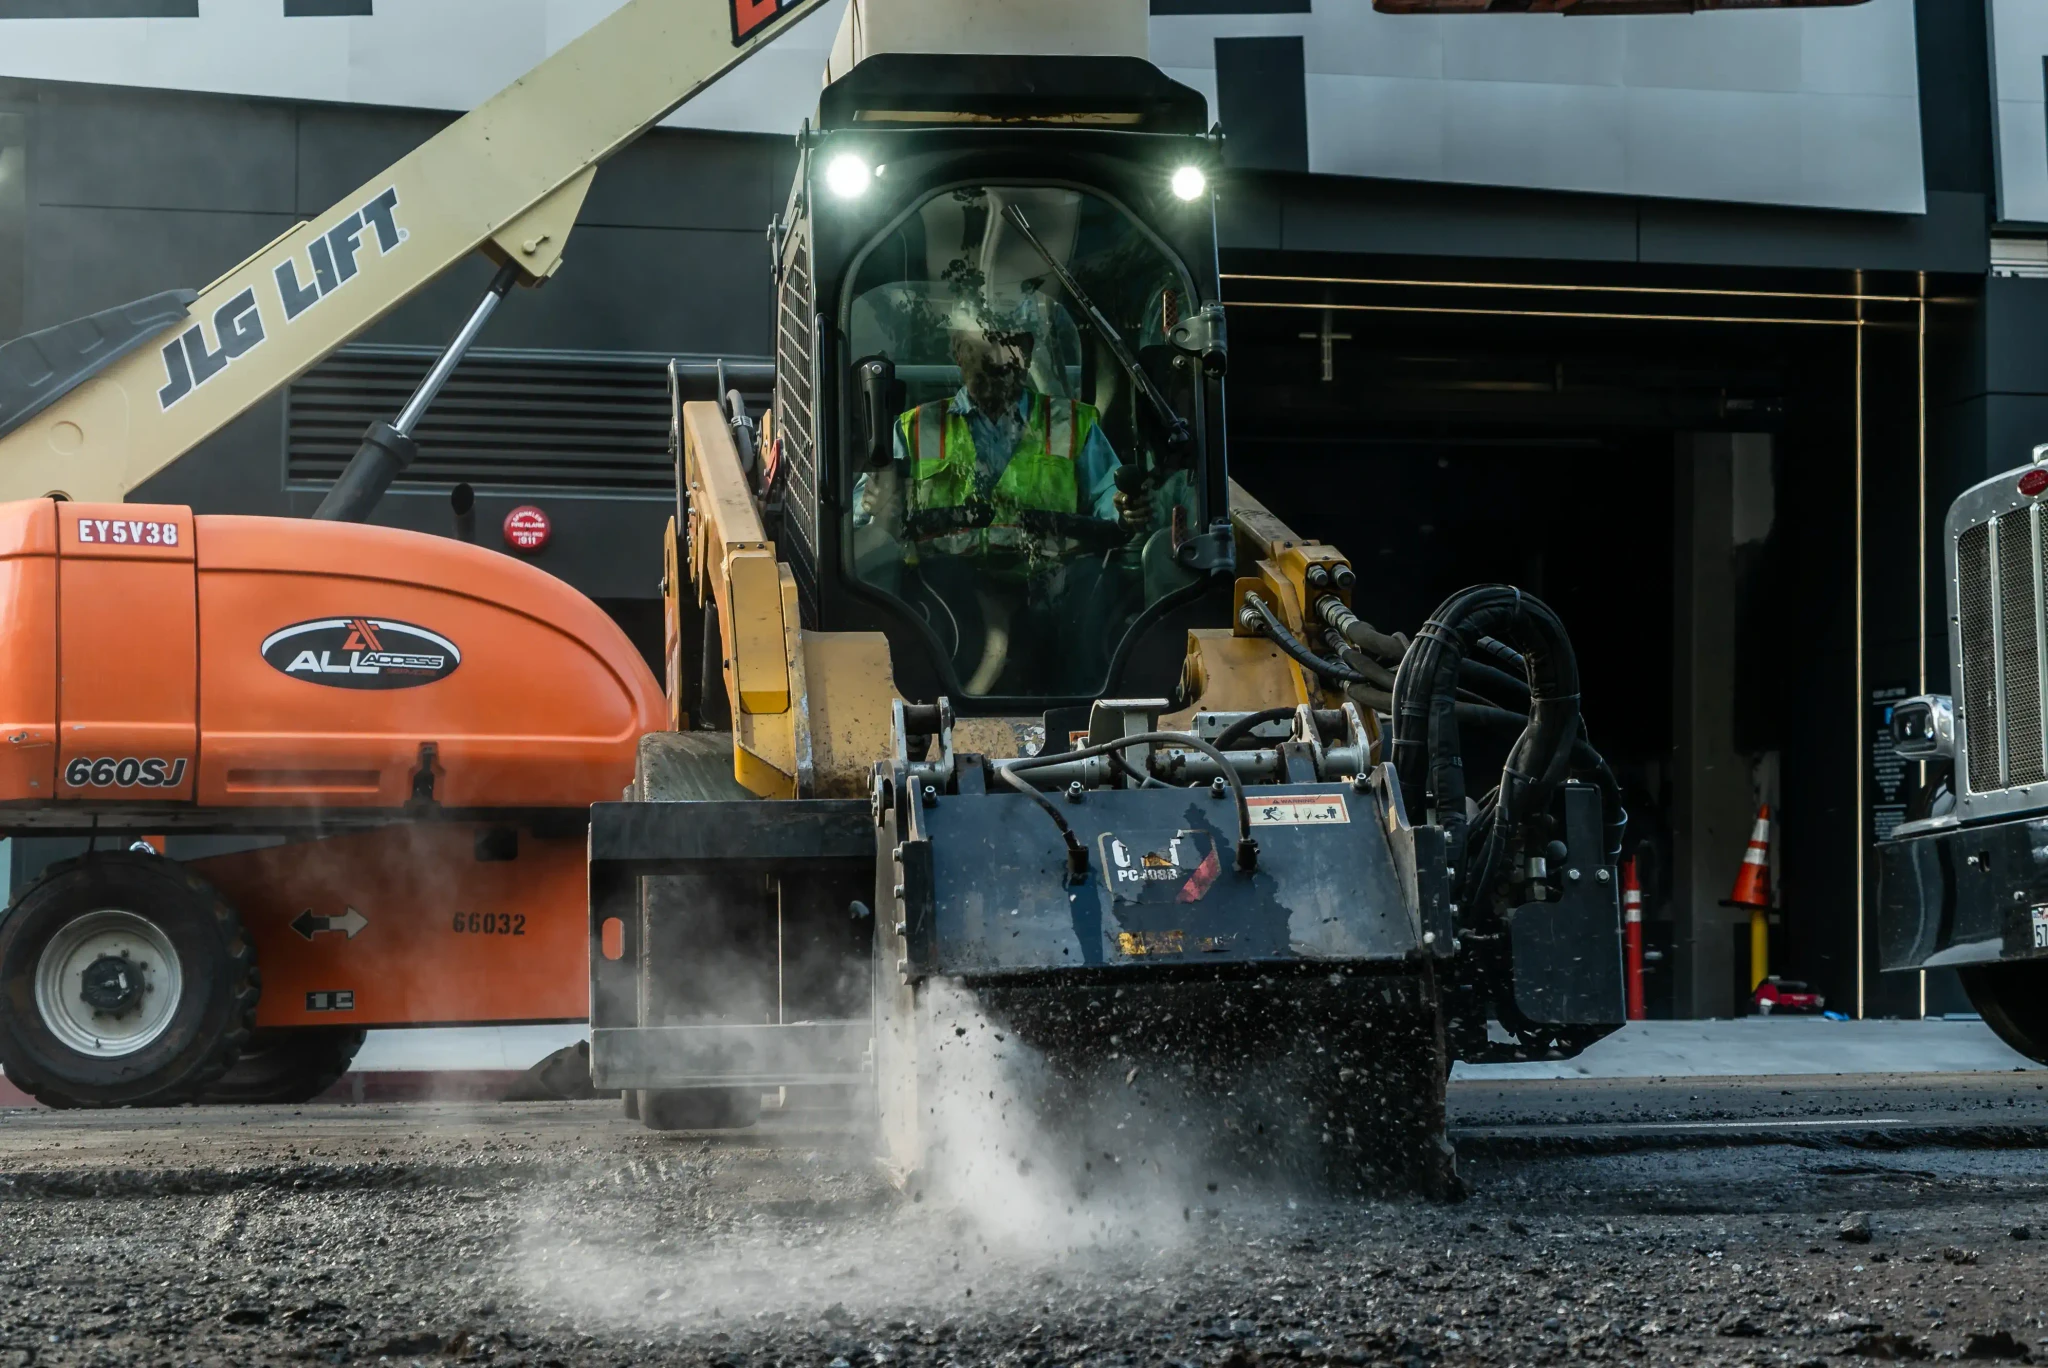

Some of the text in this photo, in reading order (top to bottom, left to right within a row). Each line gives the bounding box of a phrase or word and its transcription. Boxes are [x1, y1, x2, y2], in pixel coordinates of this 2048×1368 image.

[156, 284, 267, 413] JLG
[79, 519, 178, 545] EY5V38
[285, 650, 443, 674] ALL ACCESS
[65, 757, 187, 788] 660SJ
[453, 911, 526, 936] 66032
